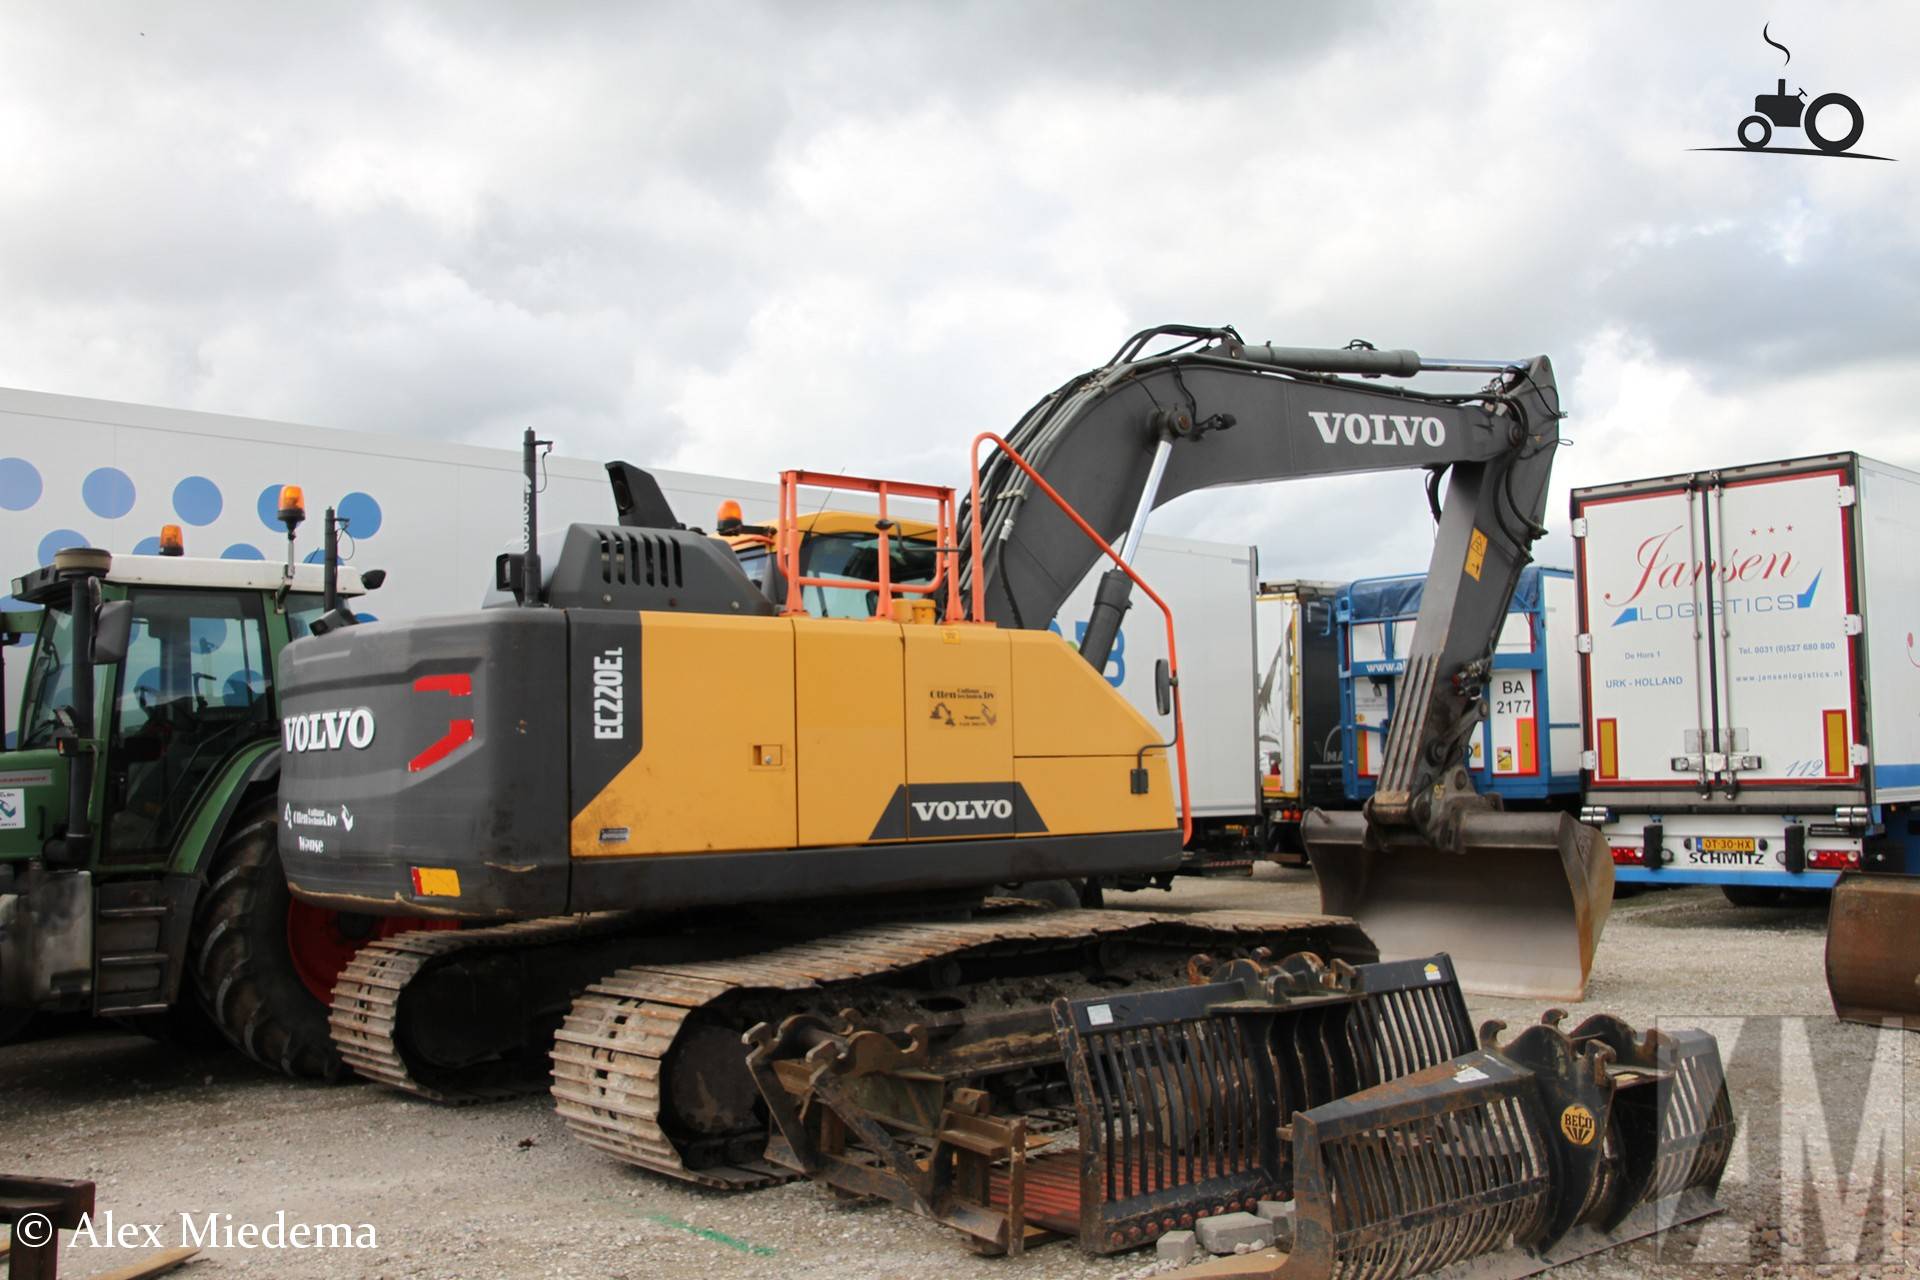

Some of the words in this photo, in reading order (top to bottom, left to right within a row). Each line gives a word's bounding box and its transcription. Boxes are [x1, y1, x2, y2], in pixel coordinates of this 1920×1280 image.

[1308, 411, 1446, 447] VOLVO
[1603, 524, 1799, 608] Jansen
[1639, 594, 1795, 621] LOGISTICS
[1737, 646, 1753, 655] Tel.
[1605, 679, 1626, 689] URK
[1635, 676, 1683, 687] HOLLAND
[1735, 669, 1843, 683] www.jansenlogistics.nl
[1502, 680, 1525, 694] BA
[1496, 700, 1531, 714] 2177
[283, 707, 375, 752] VOLVO
[1785, 759, 1824, 777] 112
[912, 799, 1013, 821] VOLVO
[1689, 851, 1765, 865] SCHMITZ
